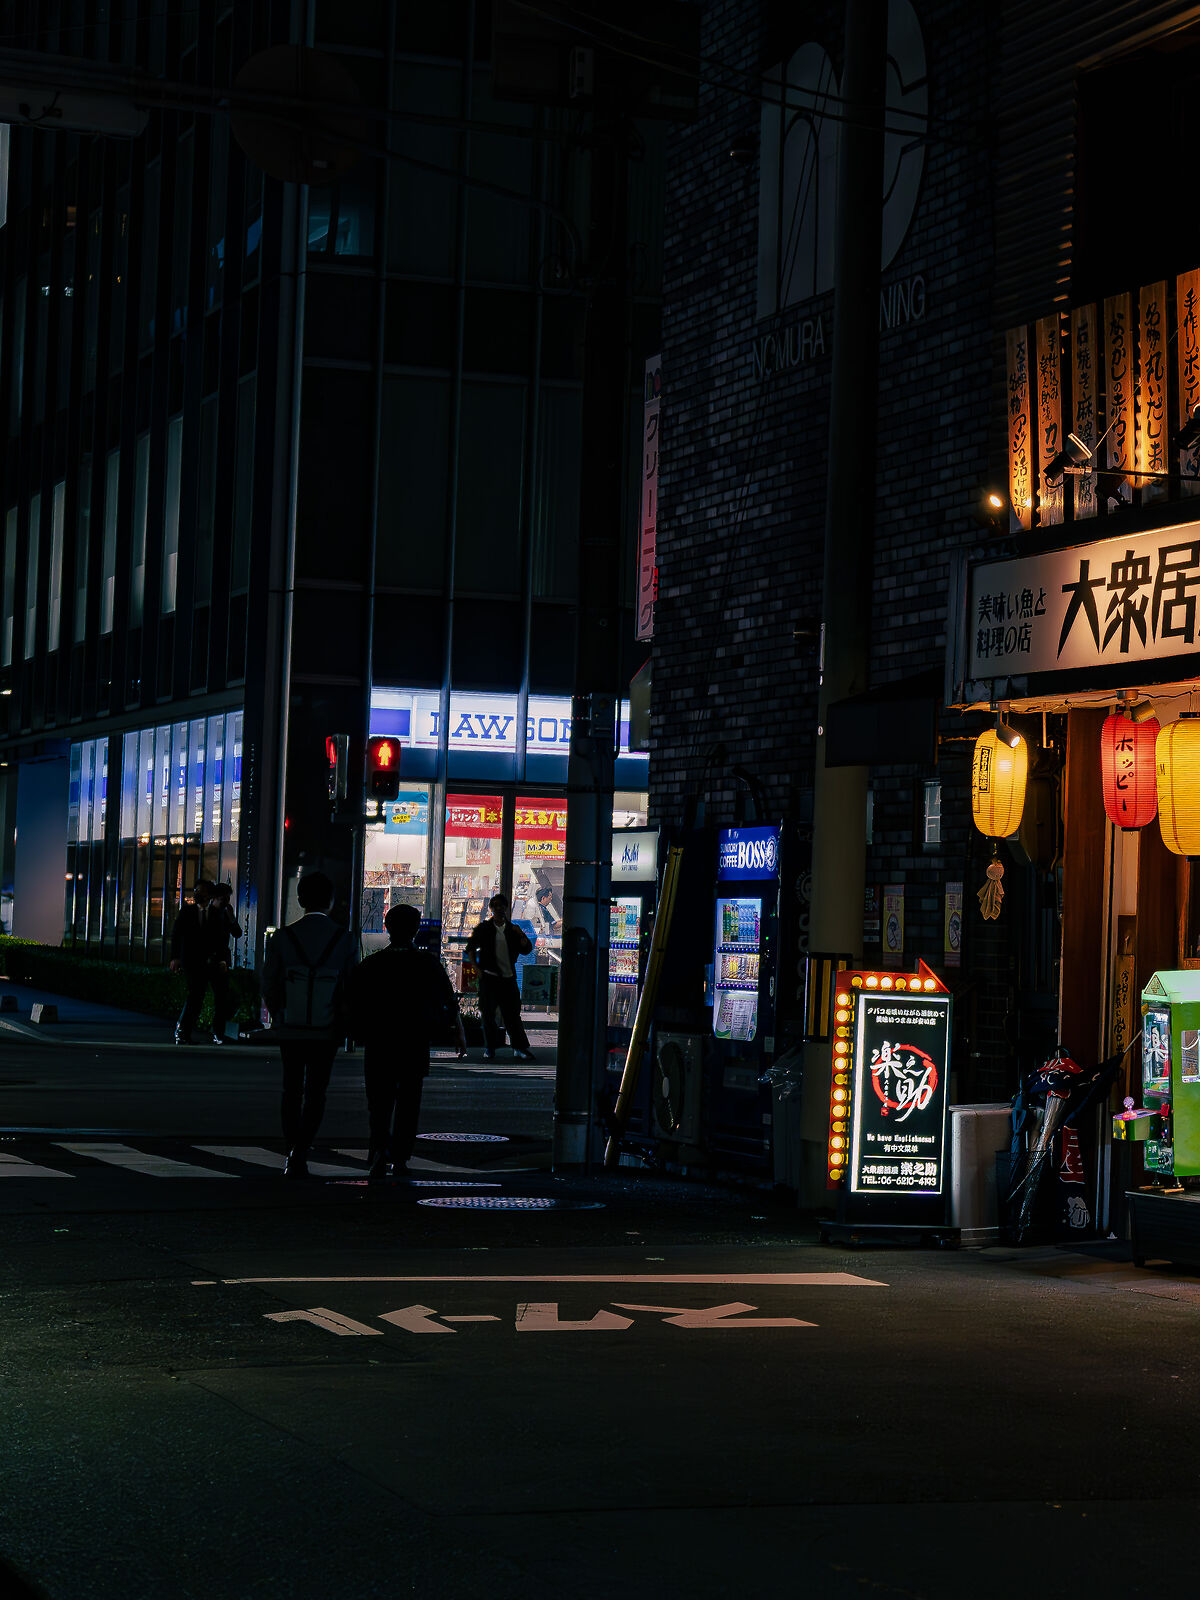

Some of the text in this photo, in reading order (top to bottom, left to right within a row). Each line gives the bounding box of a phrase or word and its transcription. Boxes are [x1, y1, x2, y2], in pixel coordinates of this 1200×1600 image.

[751, 273, 927, 379] NOMURA NING
[978, 587, 1047, 625] 美味い魚と
[976, 622, 1033, 659] 料理の店
[1115, 734, 1135, 811] ホッピー
[719, 855, 738, 868] COFFEE
[738, 840, 765, 869] BOSS
[869, 1040, 933, 1122] 楽之助
